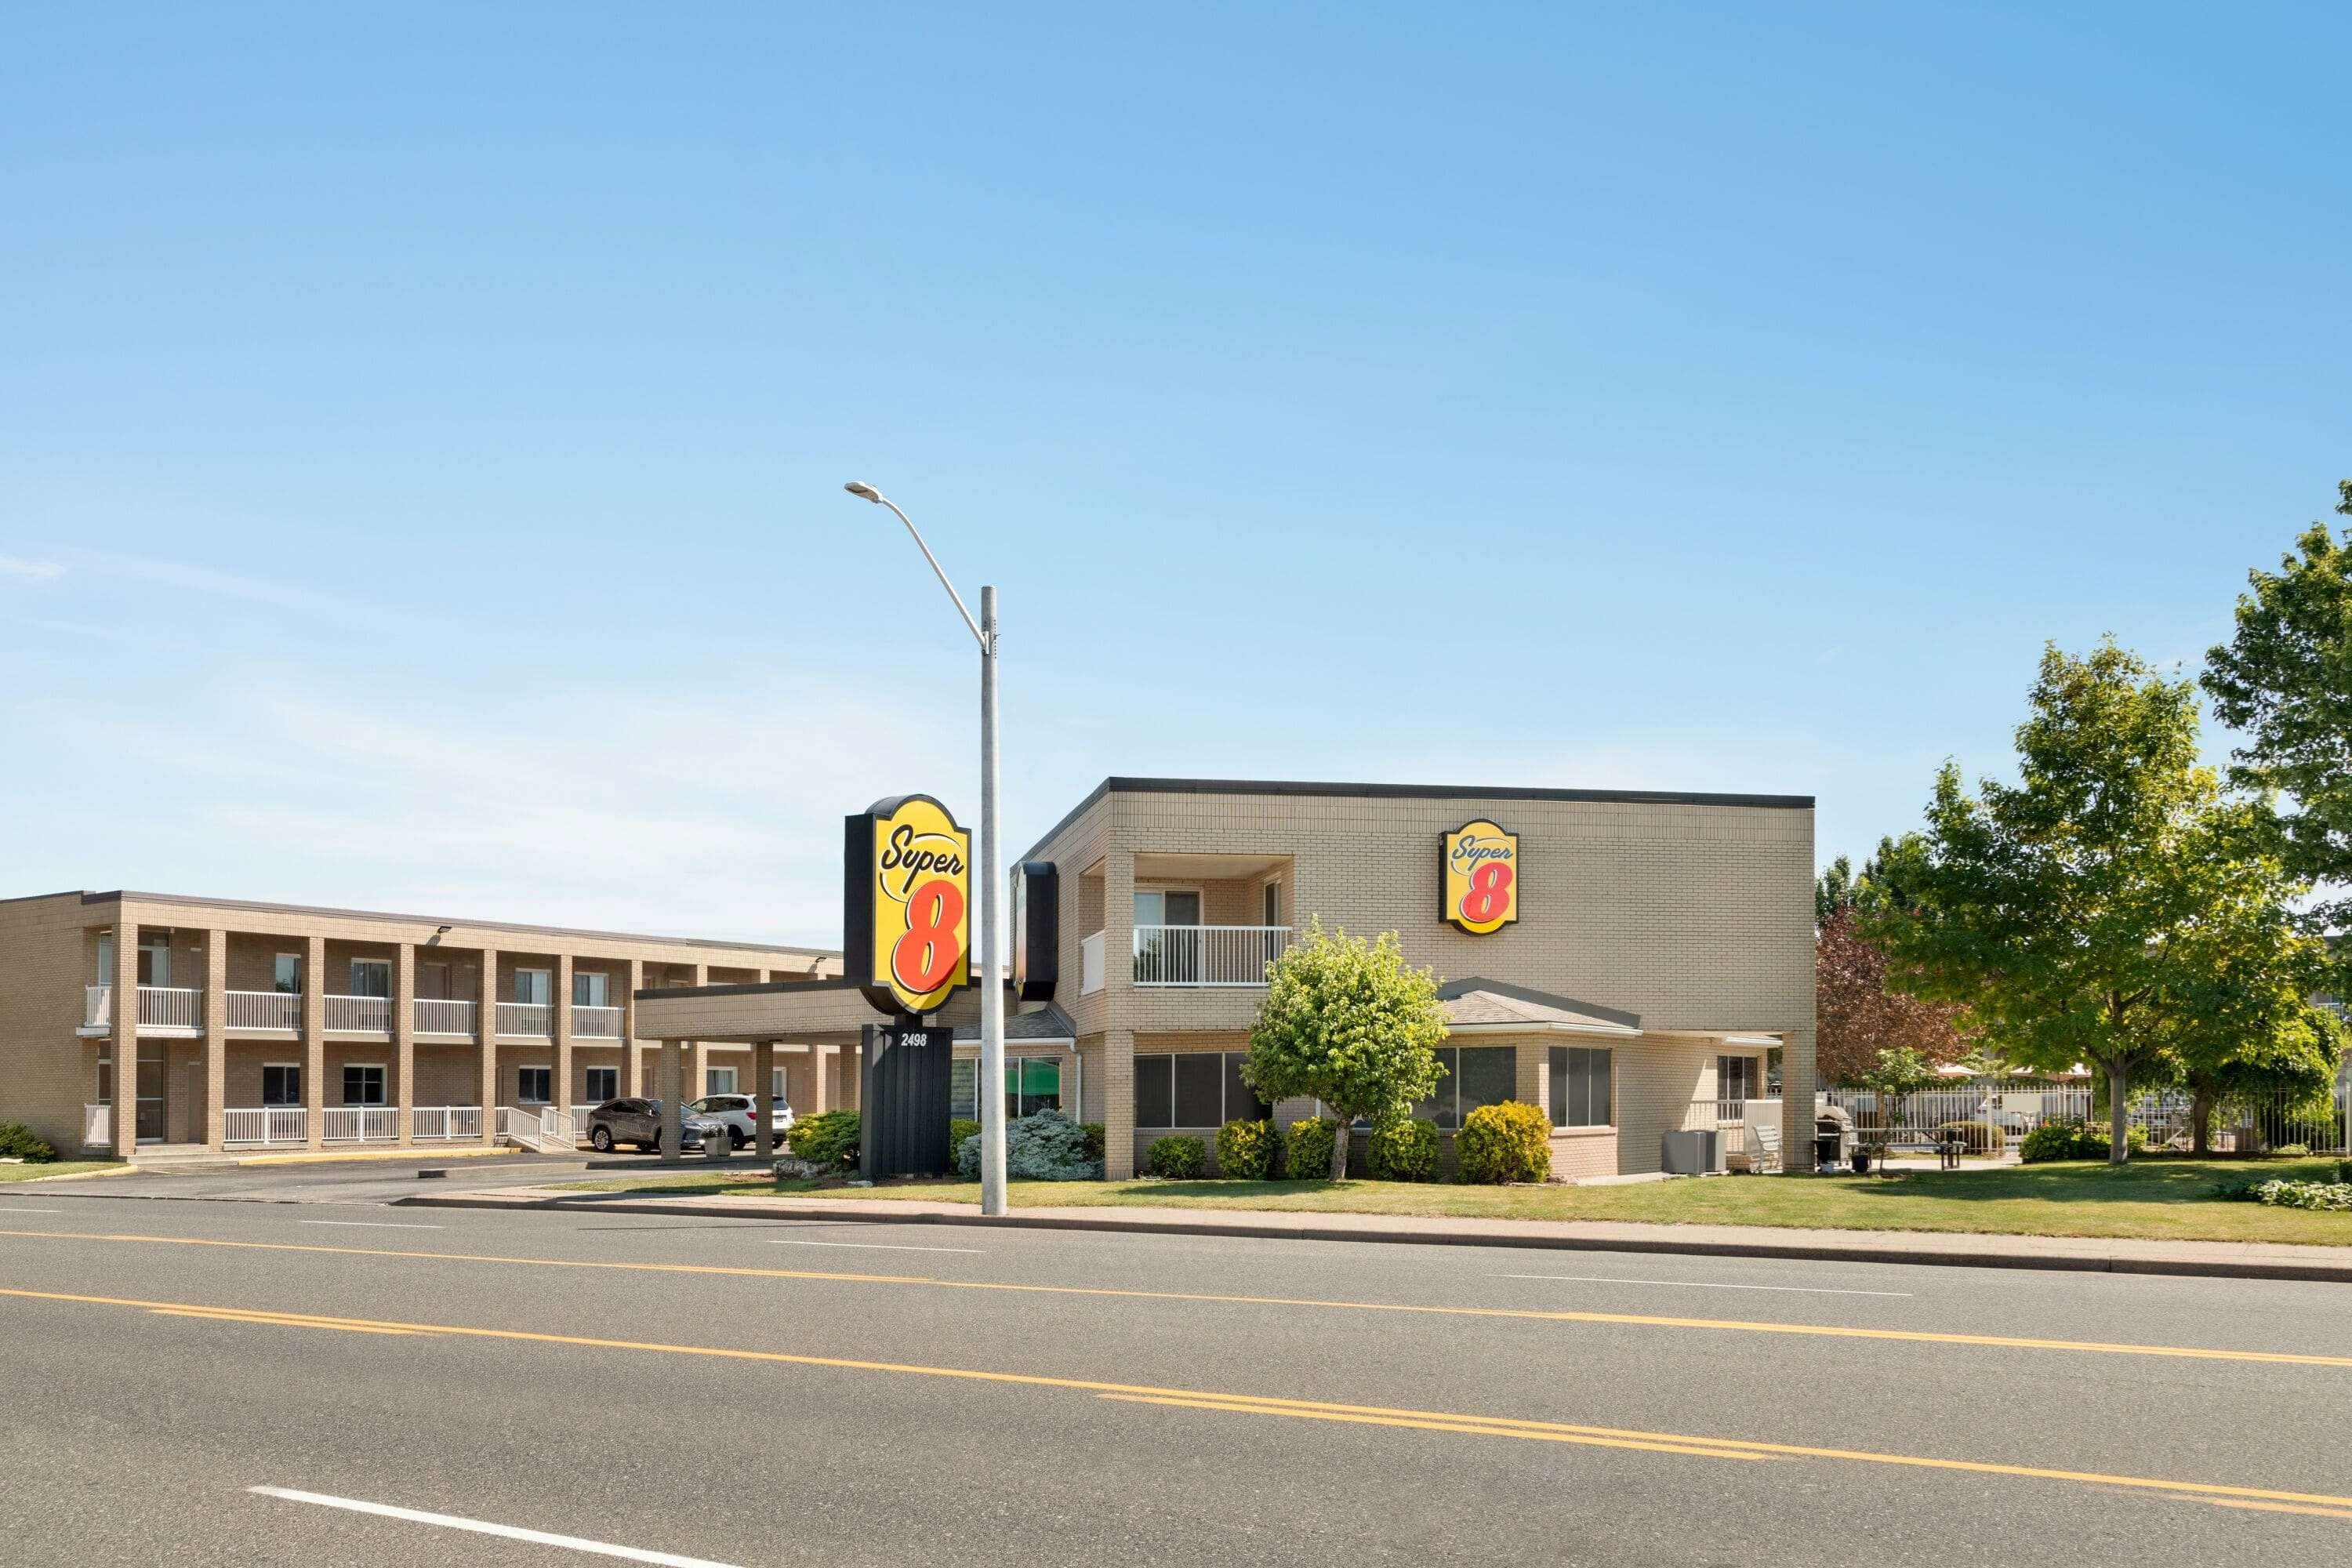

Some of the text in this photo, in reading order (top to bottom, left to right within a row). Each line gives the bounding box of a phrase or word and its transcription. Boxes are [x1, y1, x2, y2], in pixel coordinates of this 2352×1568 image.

[881, 824, 964, 894] Super
[1452, 835, 1514, 871] Super
[1459, 862, 1513, 923] 8
[891, 879, 964, 995] 8
[901, 1033, 927, 1047] 2498
